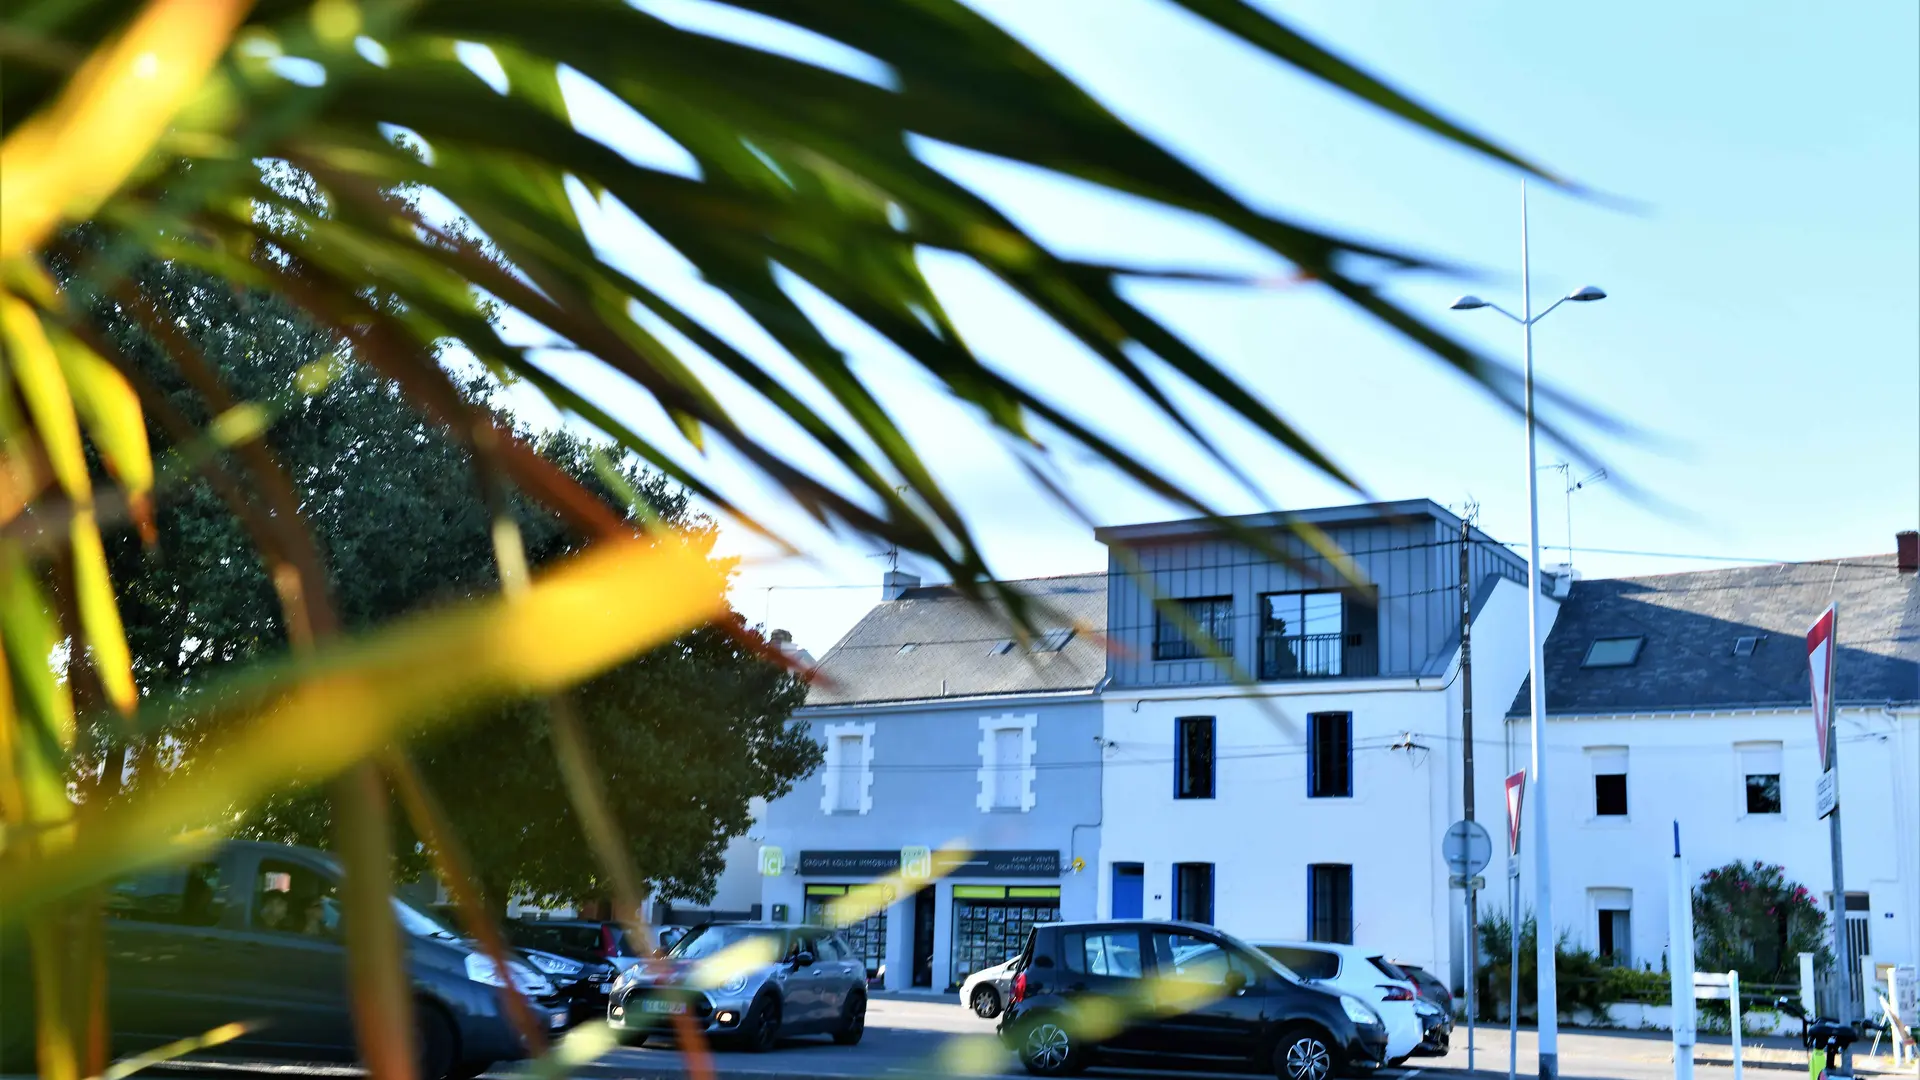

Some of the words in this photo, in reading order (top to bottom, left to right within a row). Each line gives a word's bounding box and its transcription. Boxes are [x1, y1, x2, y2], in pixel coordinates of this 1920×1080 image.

[803, 859, 830, 868] GROUPE
[859, 859, 898, 868] IMMOBILIER
[1028, 863, 1056, 872] GESTION
